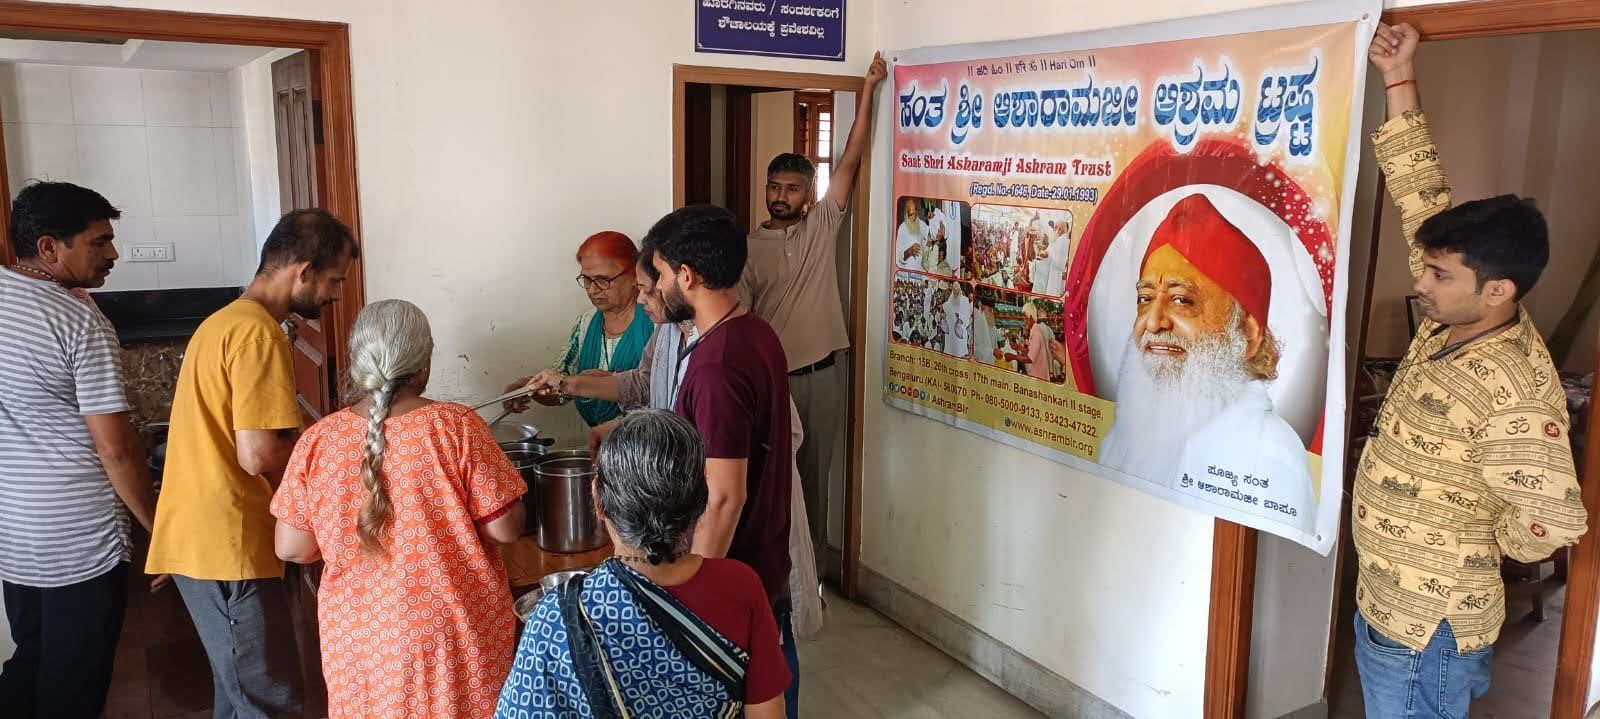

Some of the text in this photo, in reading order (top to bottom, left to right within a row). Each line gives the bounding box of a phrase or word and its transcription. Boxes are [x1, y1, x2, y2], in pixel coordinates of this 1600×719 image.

[780, 4, 839, 19] ಸಂದರ್ಶಕರಿಗೆ
[718, 16, 825, 39] ಶೌಚಾಲಯಕ್ಕೆ ಪ್ರವೇಶವಿಲ್ಲ
[1050, 59, 1067, 71] Hari
[1069, 58, 1085, 69] Om
[900, 84, 947, 128] ಸಂತ
[950, 84, 983, 144] ಶ್ರೀ
[994, 75, 1139, 128] ಆಶಾರಾಮಜೀ
[1154, 63, 1240, 145] ಆಶ್ರಮ
[901, 154, 1112, 176] Sant Shri Asharamji Ashram Trust
[970, 182, 995, 197] (Regd.
[1031, 185, 1098, 205] Date-29.01.1993)
[889, 350, 915, 363] Branch:
[934, 361, 947, 373] 26th
[949, 368, 971, 381] cross,
[973, 371, 988, 384] 17th
[990, 378, 1011, 393] main,
[1013, 382, 1068, 409] Banashankari
[1070, 399, 1076, 410] II
[1078, 403, 1104, 420] stage,
[889, 366, 924, 384] Bengaluru
[971, 389, 984, 401] Ph-
[985, 394, 1042, 421] 080-5000-9133,
[932, 394, 969, 414] AshramBlr
[1011, 419, 1093, 456] www.ashramblr.org
[1207, 465, 1269, 489] ಪೂಜ್ಯ ಸಂತ
[1180, 472, 1297, 517] ಶ್ರೀ ಆಶಾರಾಮಜೀ ಬಾಪೂ
